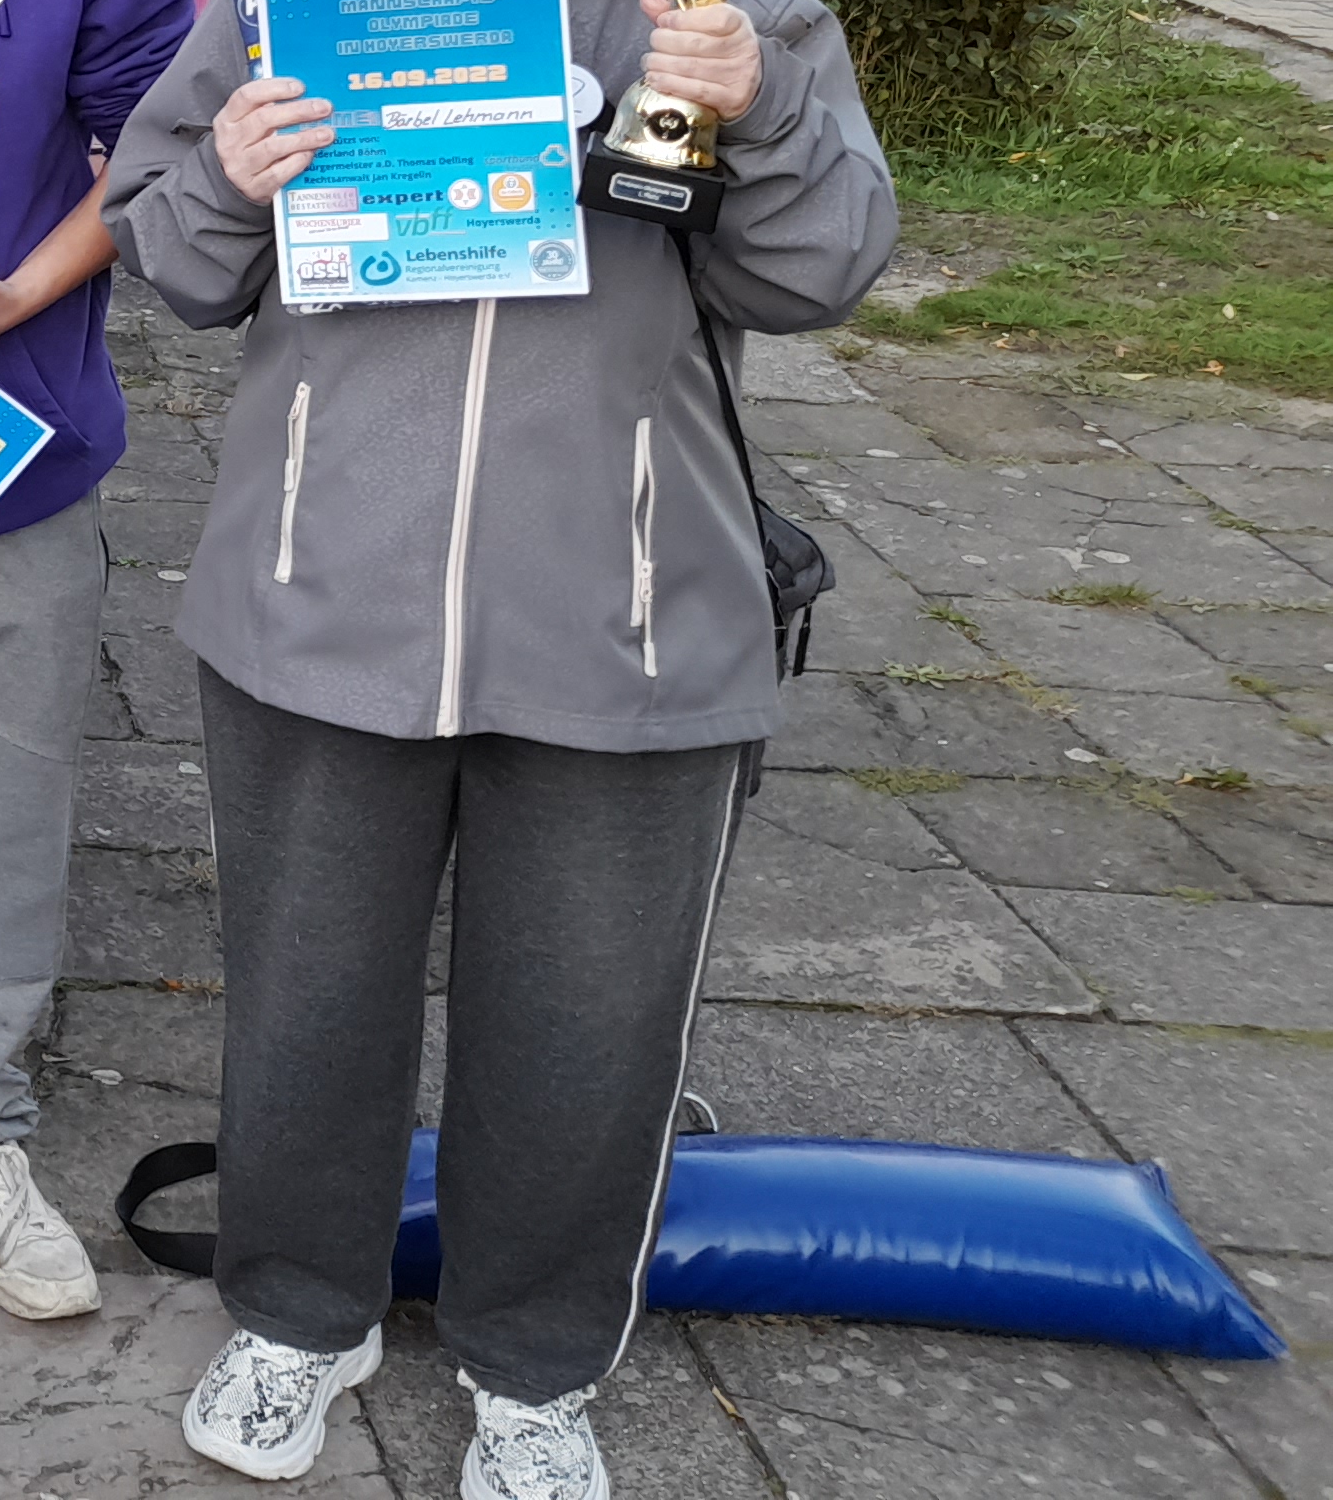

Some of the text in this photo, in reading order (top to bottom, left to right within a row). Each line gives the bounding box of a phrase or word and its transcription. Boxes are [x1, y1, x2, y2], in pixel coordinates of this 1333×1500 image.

[367, 11, 480, 32] OLYMPIADE
[337, 29, 514, 55] IN HOYERSWERDA
[348, 64, 507, 90] 16.09.2022
[444, 108, 533, 126] Lehmann
[397, 157, 436, 168] Thomas
[362, 189, 444, 205] expert
[395, 206, 454, 237] vbff
[467, 215, 541, 229] Hoyerswerda
[406, 245, 507, 262] Lebenshilfe
